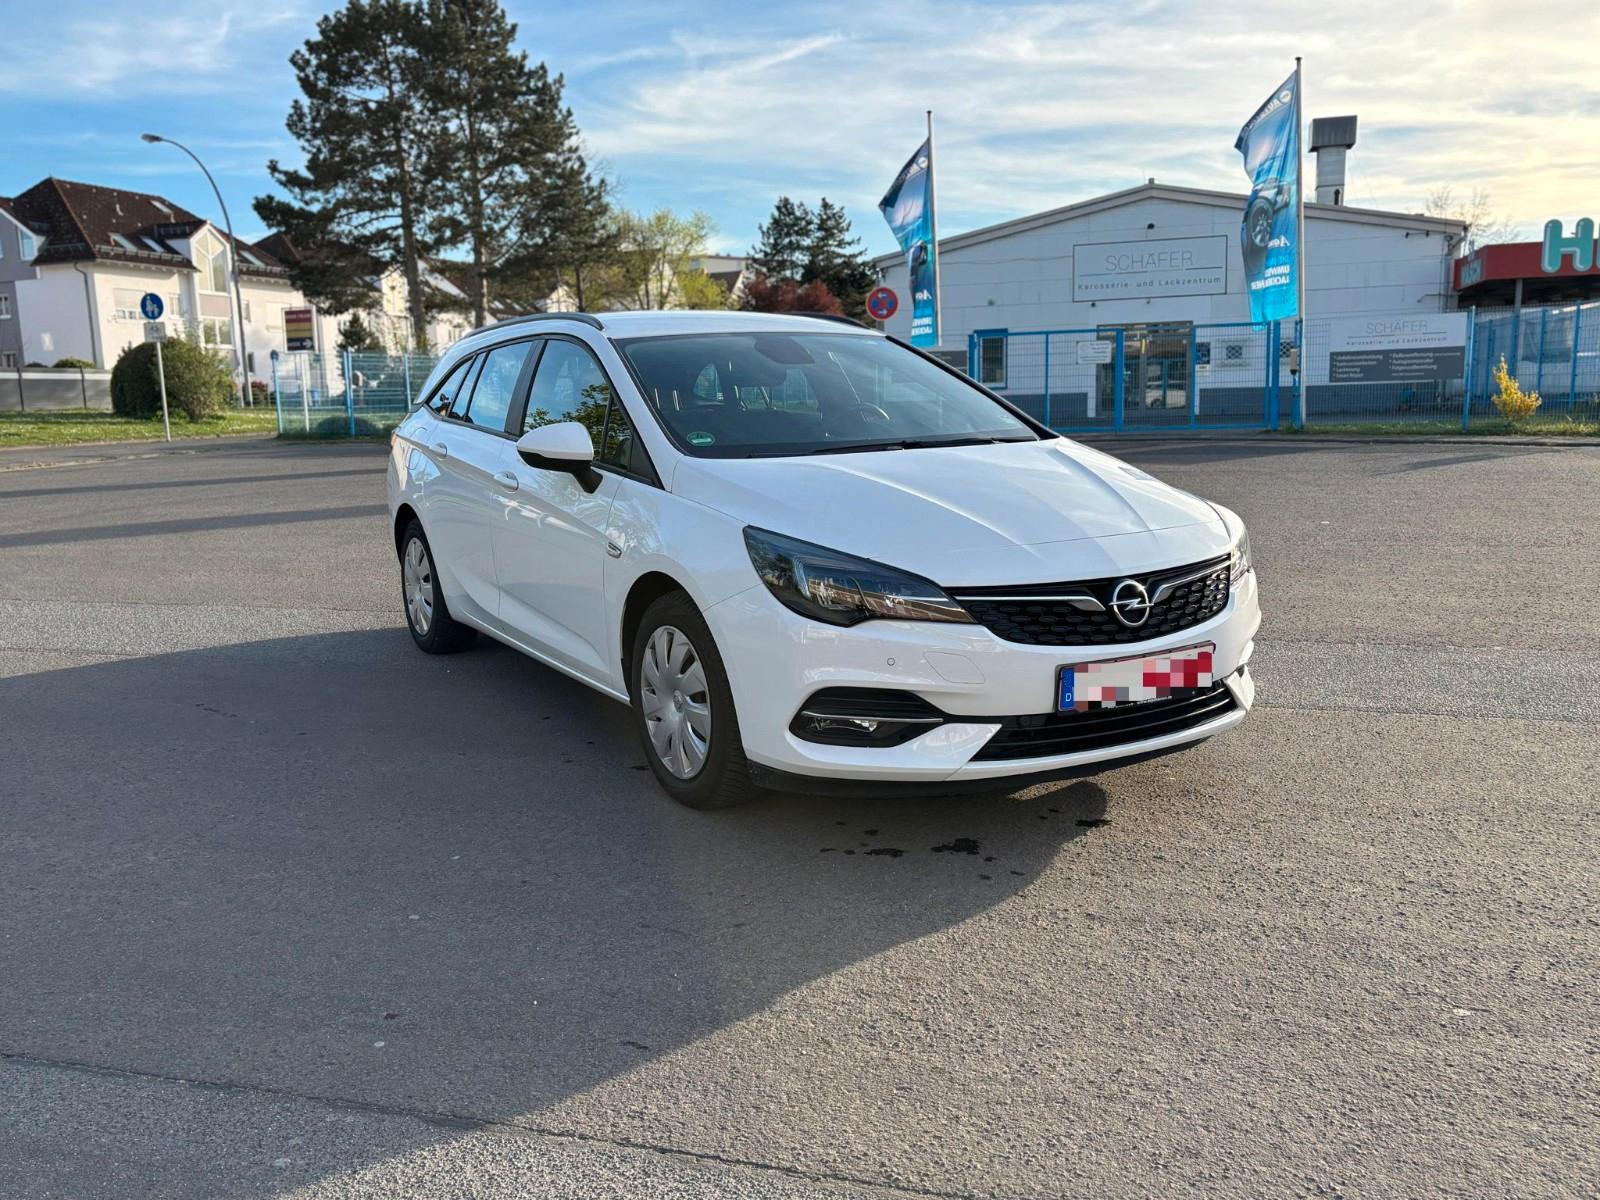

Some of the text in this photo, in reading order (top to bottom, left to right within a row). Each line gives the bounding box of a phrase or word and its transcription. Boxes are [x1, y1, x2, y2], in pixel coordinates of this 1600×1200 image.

[1542, 217, 1600, 273] H
[1104, 250, 1194, 272] SCHÄFER
[1136, 280, 1154, 288] und
[1158, 277, 1222, 287] Lackzentrum
[1365, 319, 1428, 335] SCHÄFER
[1402, 336, 1448, 344] Lackzentrum
[1065, 692, 1072, 702] D
